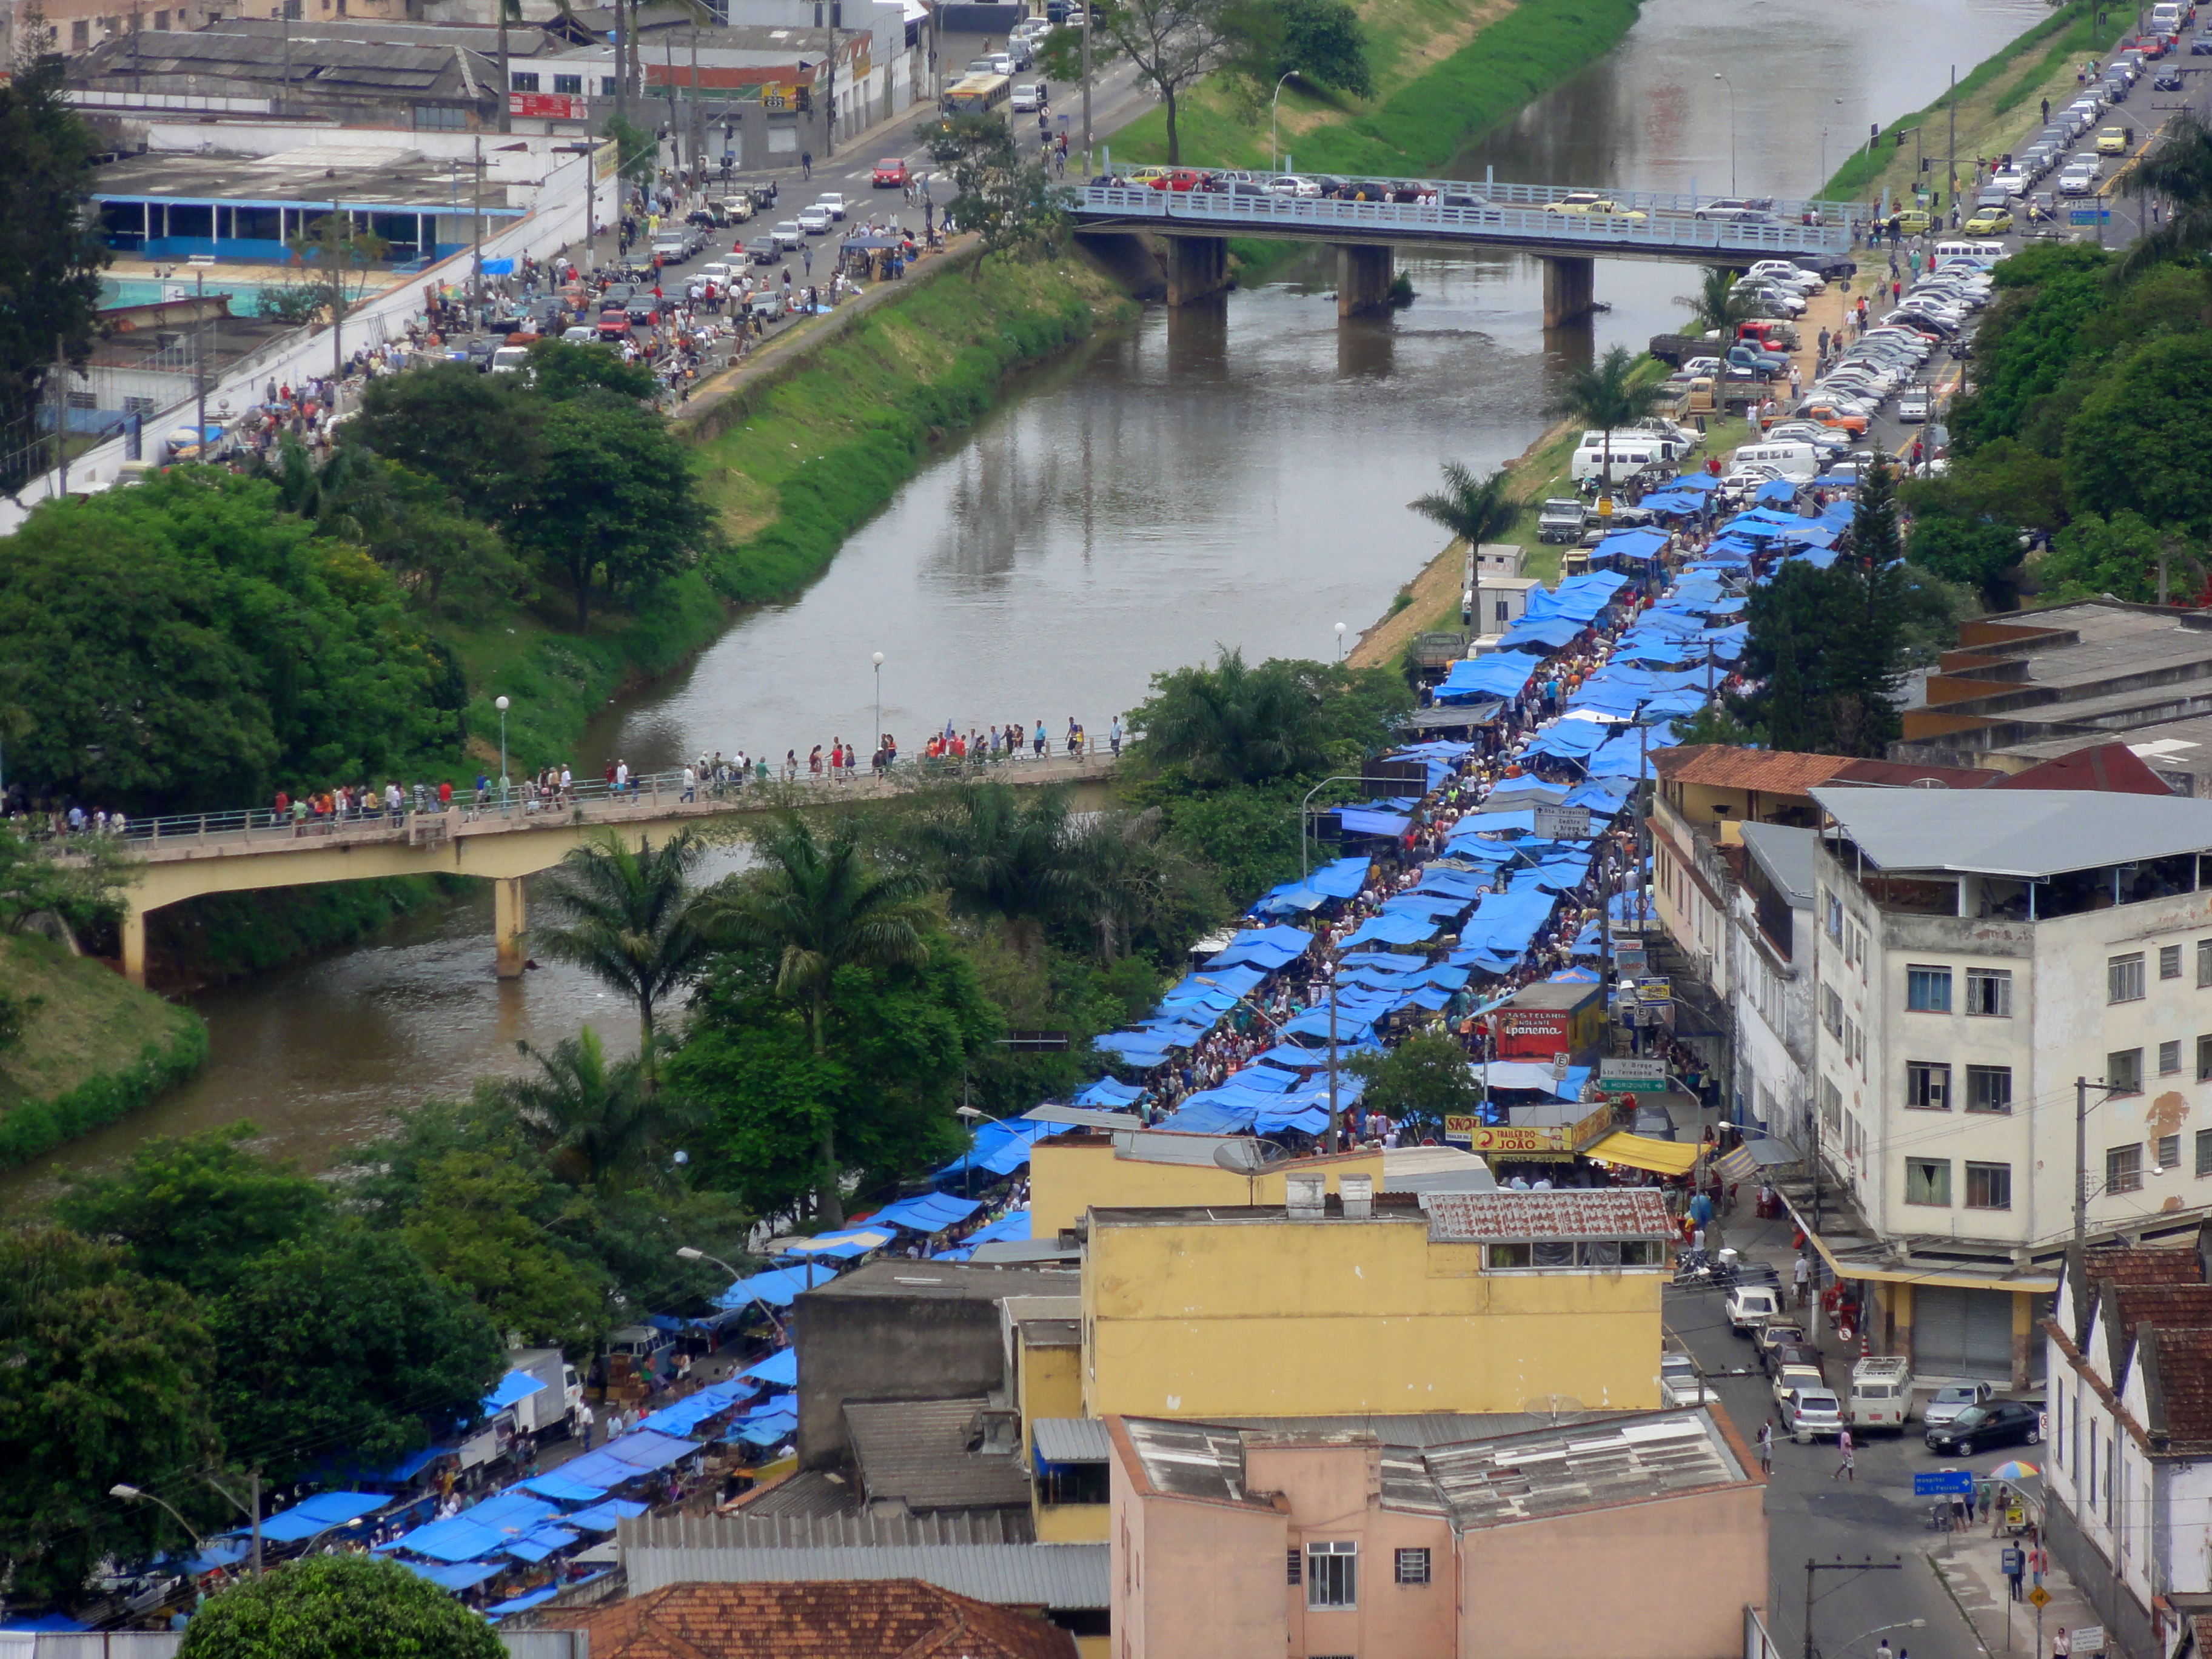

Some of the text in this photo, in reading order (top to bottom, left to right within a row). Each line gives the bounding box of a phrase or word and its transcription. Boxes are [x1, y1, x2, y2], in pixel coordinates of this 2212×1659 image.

[1506, 1025, 1563, 1036] Ipanema
[1447, 1117, 1477, 1131] SKOL
[1497, 1138, 1536, 1150] JOÃO
